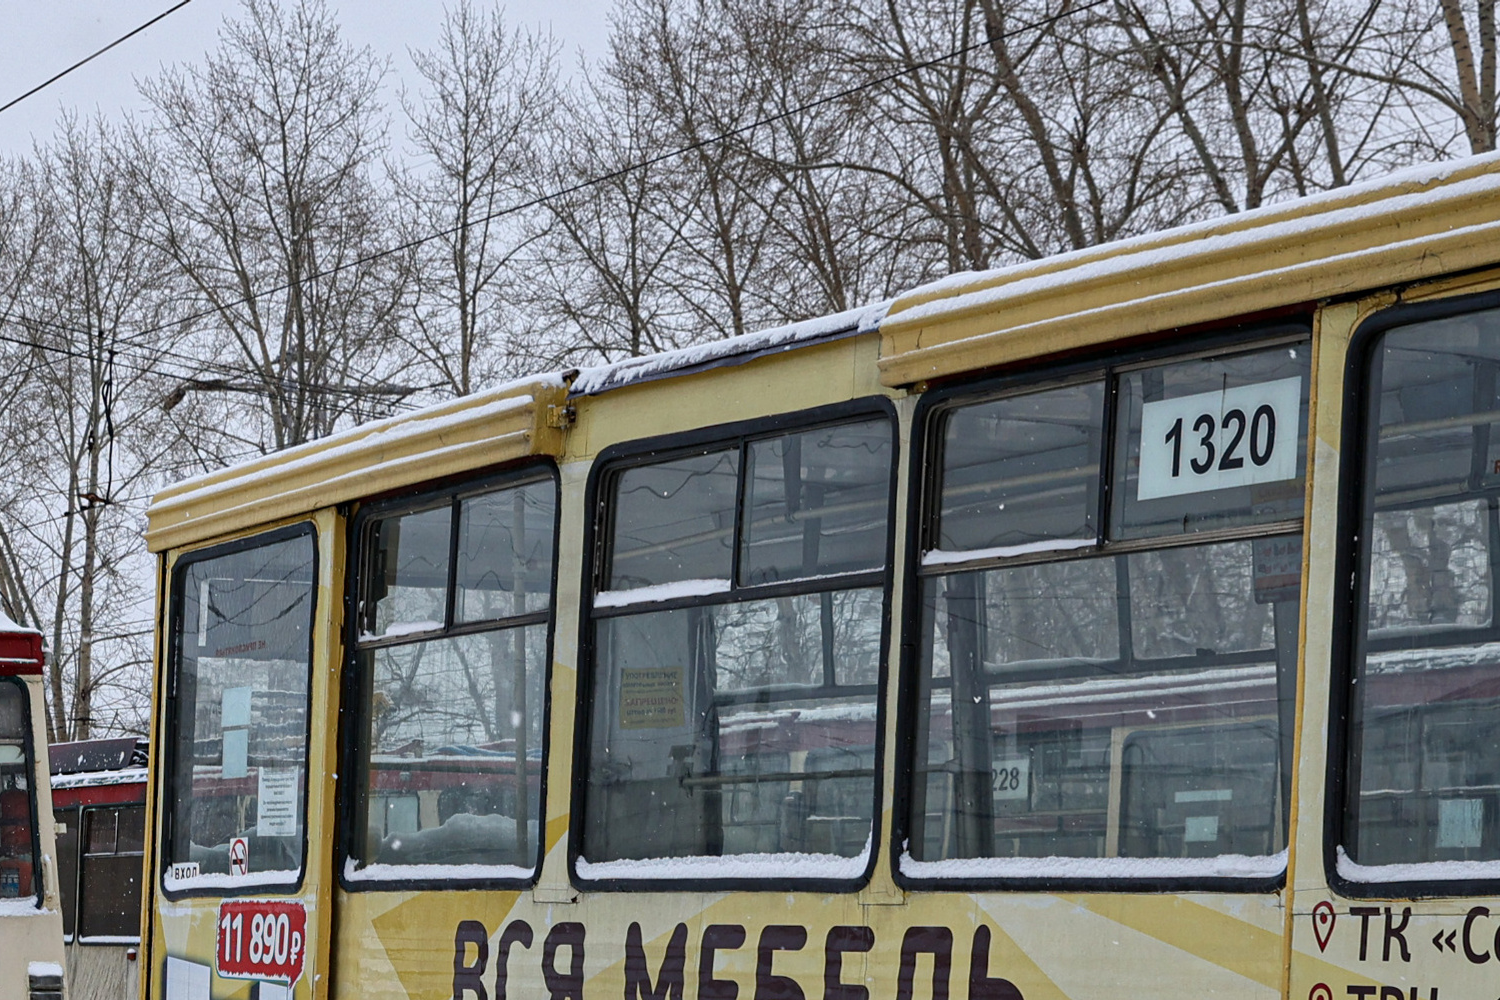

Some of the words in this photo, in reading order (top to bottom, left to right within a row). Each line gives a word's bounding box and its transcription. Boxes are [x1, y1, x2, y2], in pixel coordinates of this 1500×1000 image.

[1165, 404, 1276, 477] 1320
[221, 912, 243, 963] 11
[1349, 906, 1412, 963] ТК
